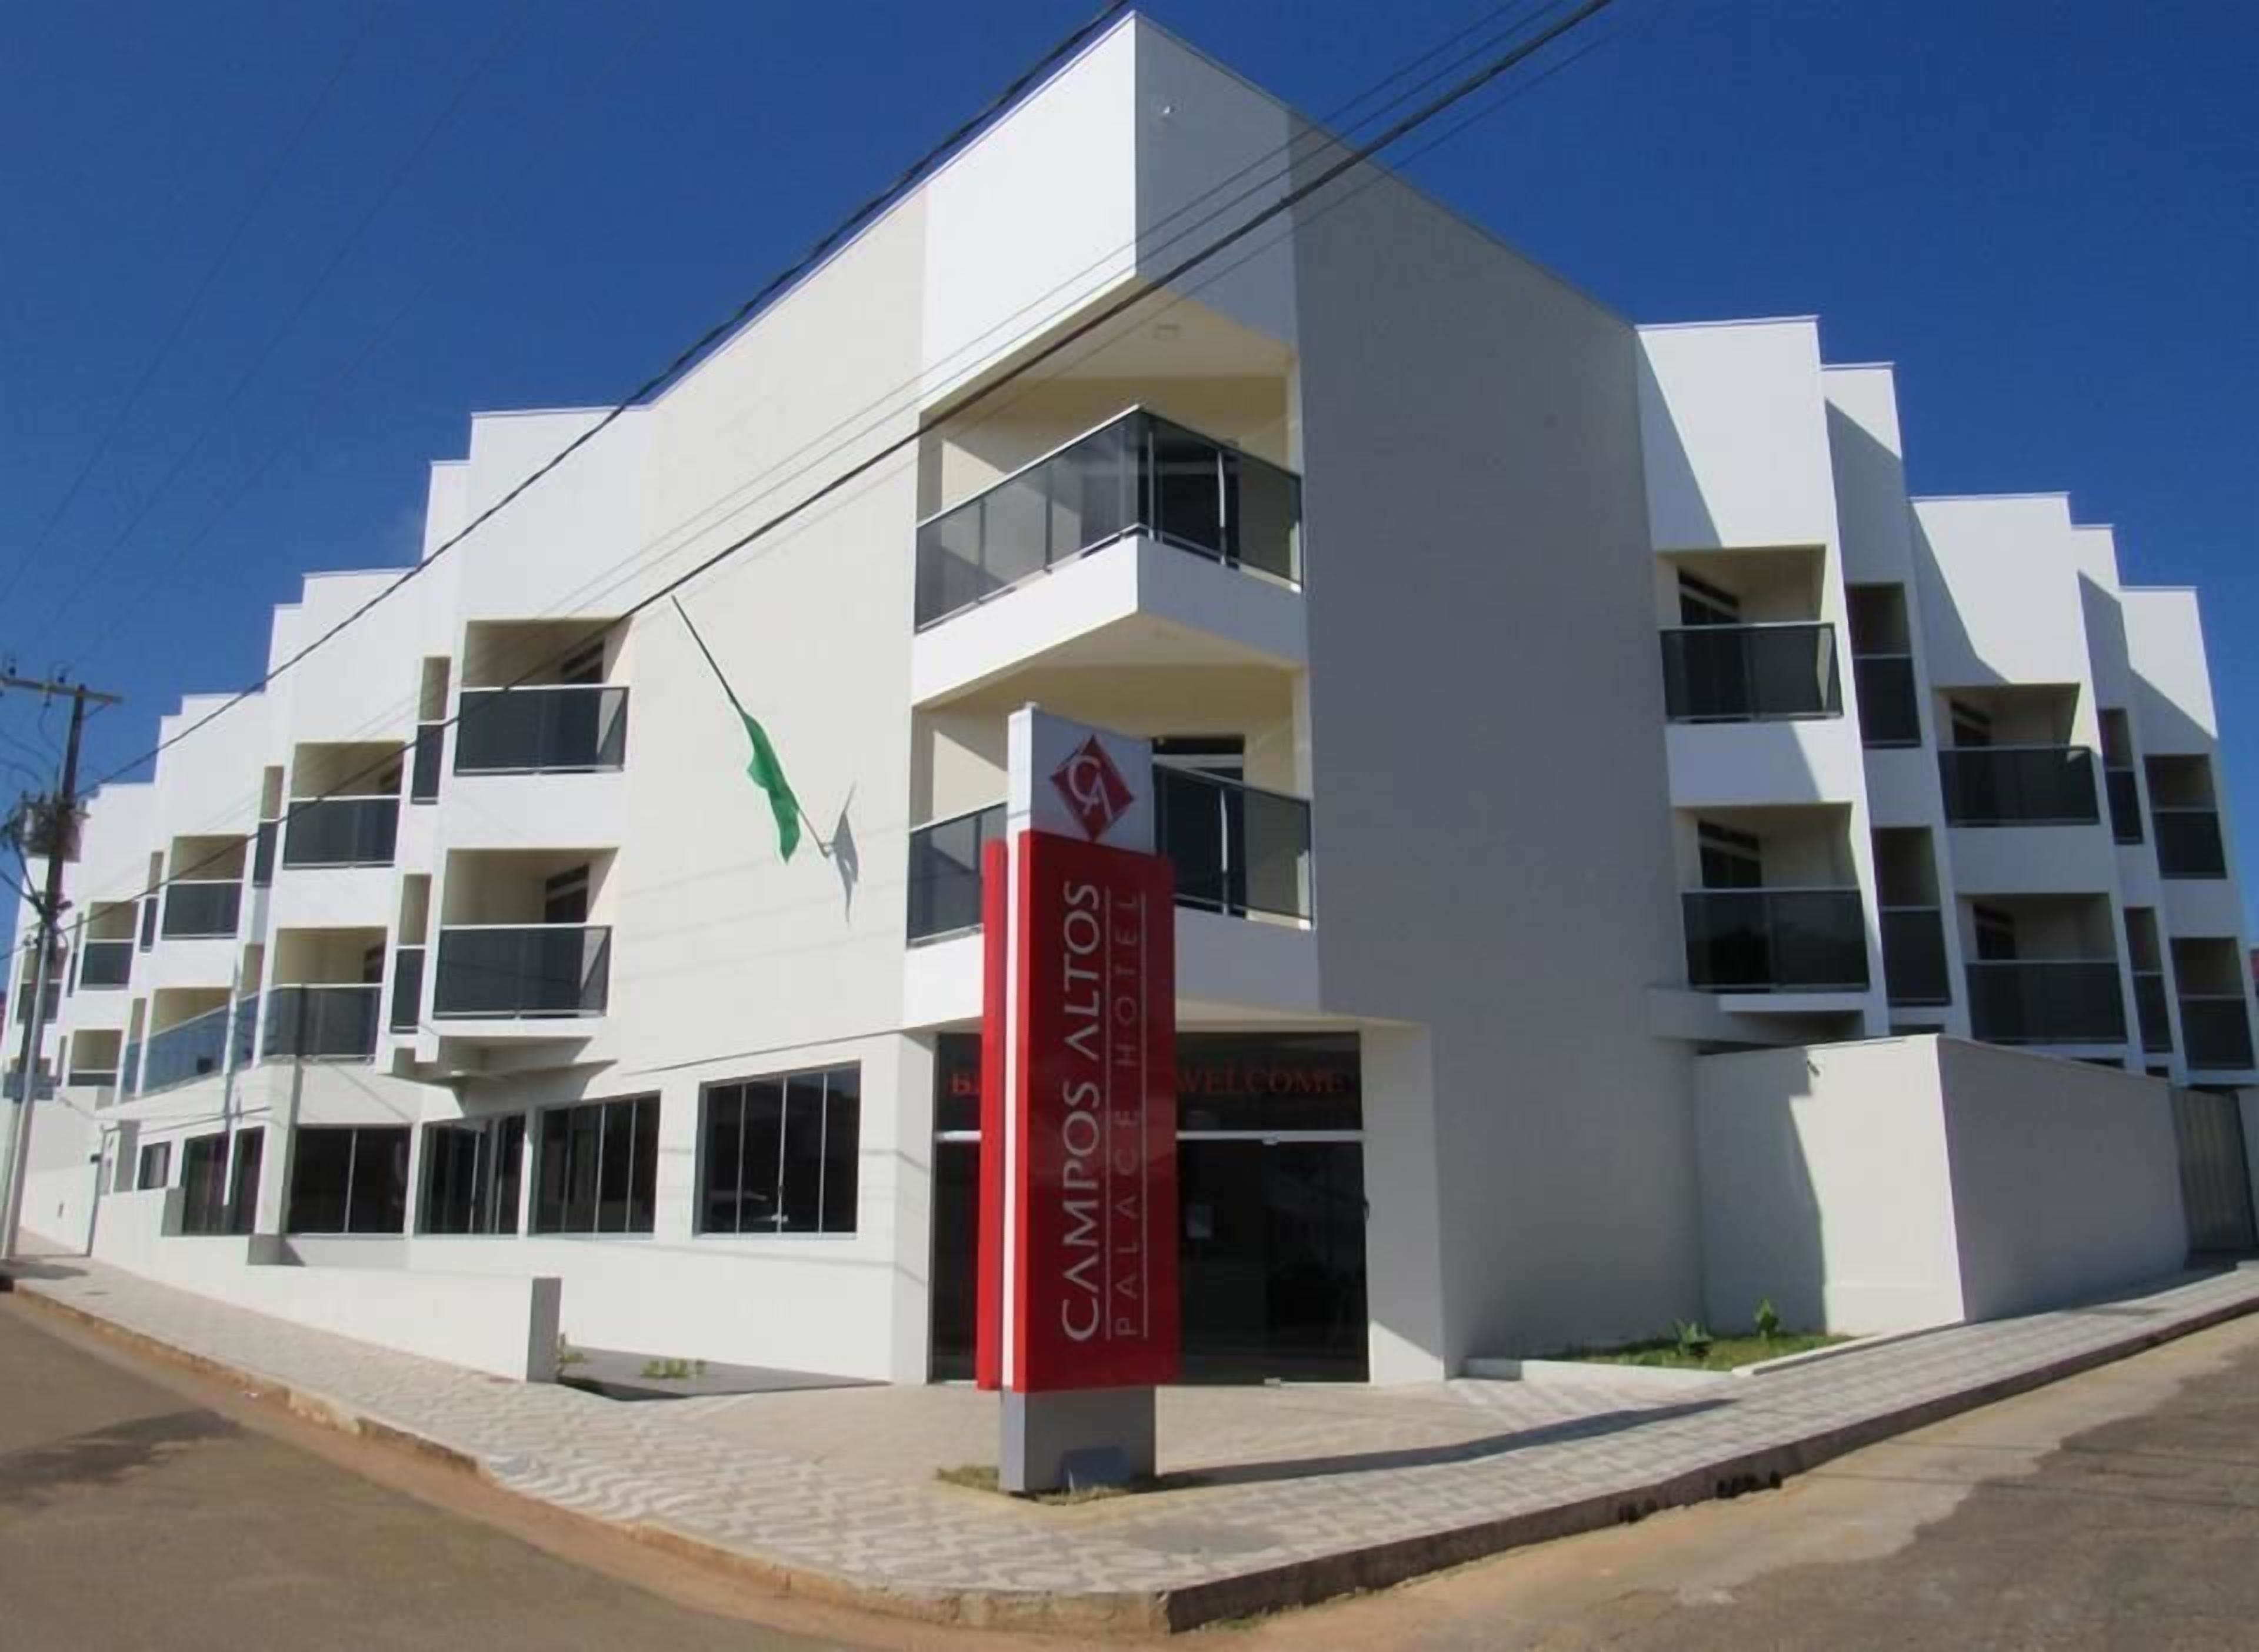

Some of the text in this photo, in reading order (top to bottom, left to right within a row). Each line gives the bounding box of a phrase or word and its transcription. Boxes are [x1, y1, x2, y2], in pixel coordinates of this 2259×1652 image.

[1061, 880, 1101, 1341] CAMPOS ALTOS
[1115, 893, 1139, 1337] PALACE HOTEL
[1175, 1067, 1347, 1095] WELCOME
